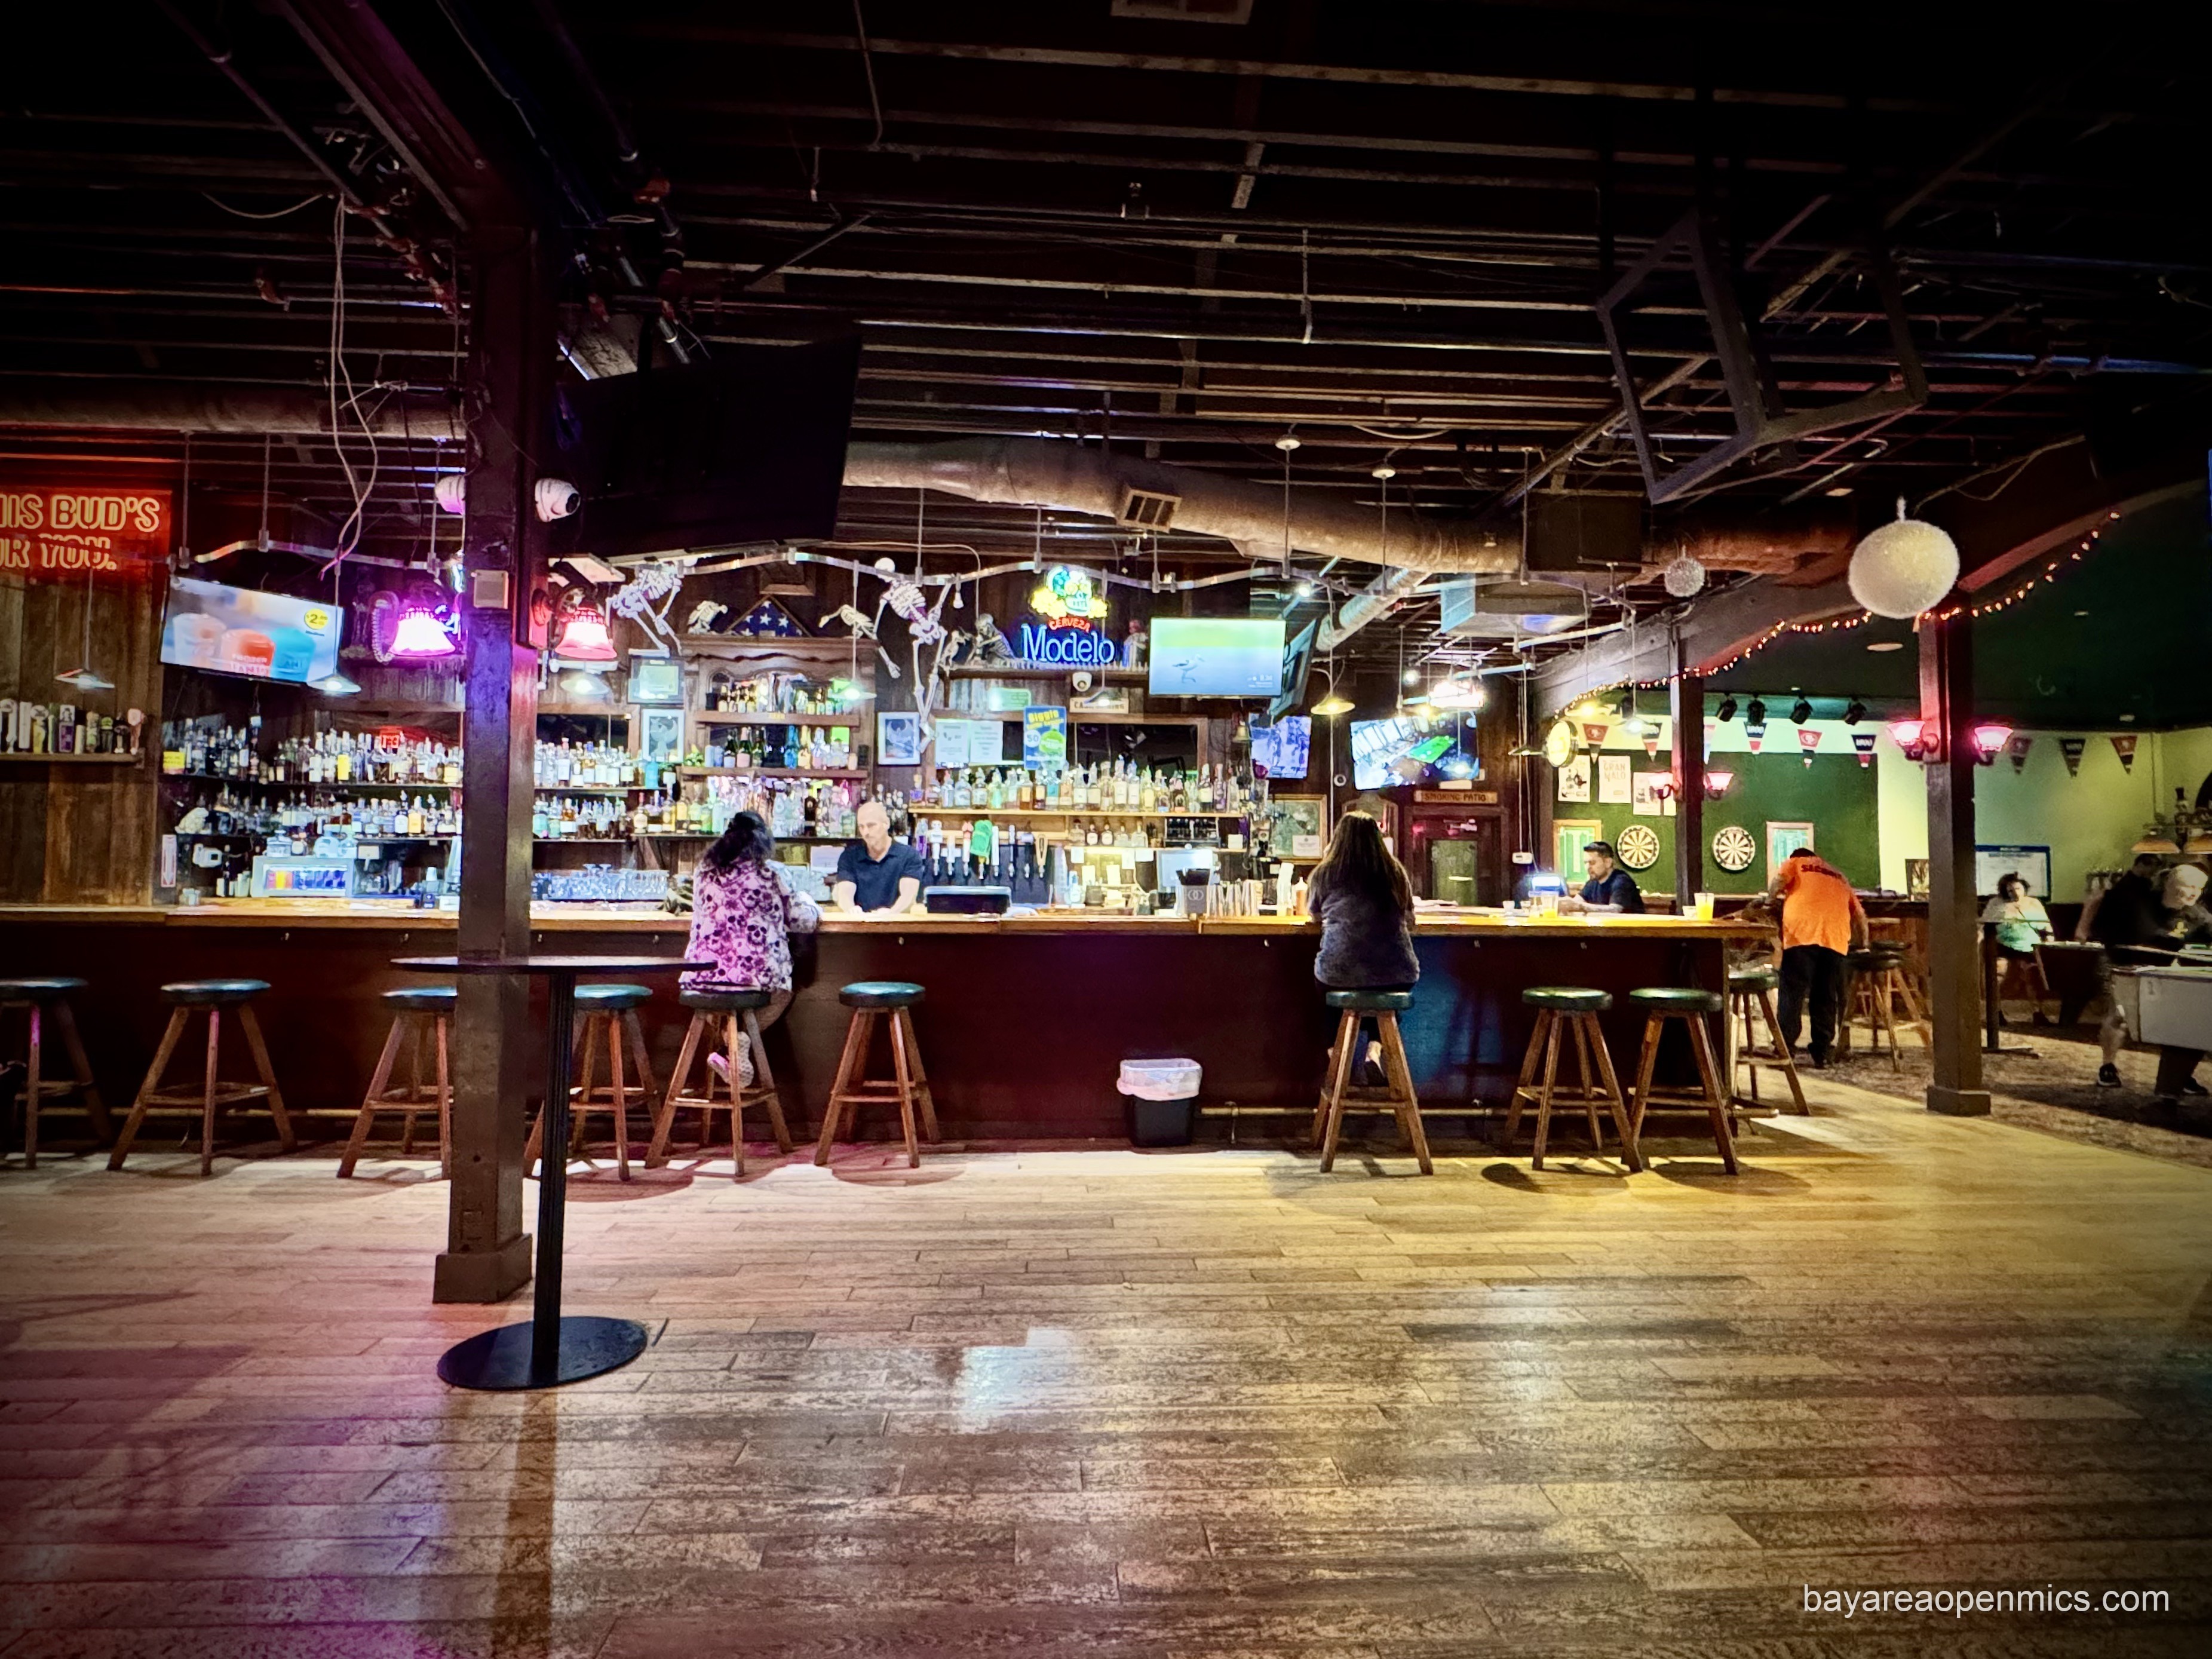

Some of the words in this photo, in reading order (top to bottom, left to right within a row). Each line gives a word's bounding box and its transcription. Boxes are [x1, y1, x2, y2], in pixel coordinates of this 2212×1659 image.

[0, 494, 44, 529] IS
[50, 495, 160, 533] BUD'S
[0, 538, 30, 568] R
[1048, 616, 1091, 633] CERVEZA
[1021, 623, 1115, 664] Modelo
[1603, 763, 1626, 771] GRAN
[1425, 793, 1461, 802] SMOKING
[1464, 793, 1486, 802] PATIO
